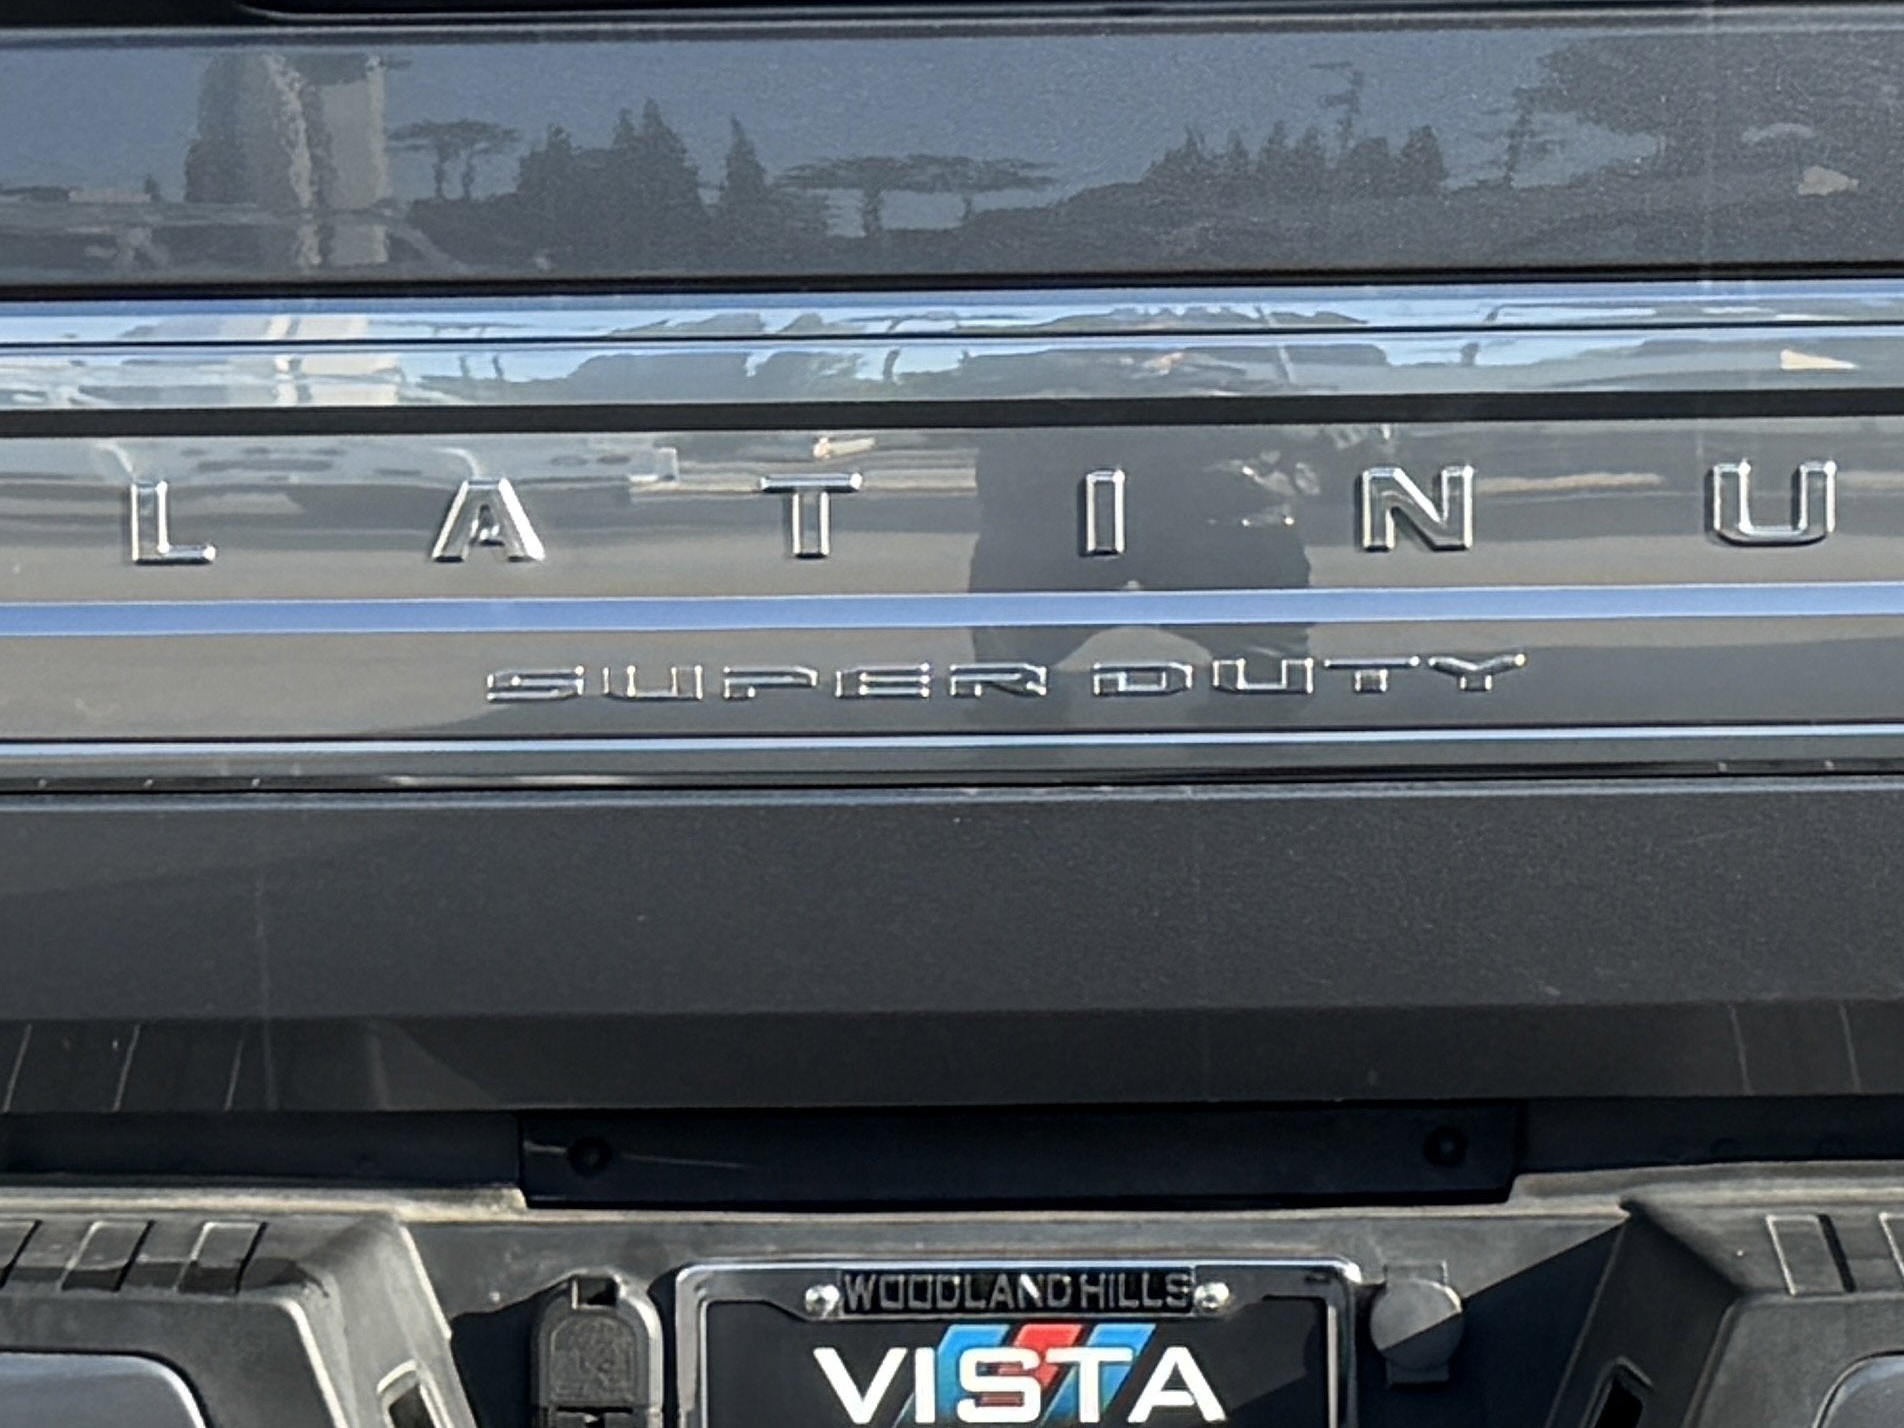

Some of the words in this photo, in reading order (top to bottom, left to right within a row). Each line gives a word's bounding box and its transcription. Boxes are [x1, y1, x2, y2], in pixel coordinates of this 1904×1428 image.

[487, 661, 1047, 701] SUPER
[1092, 653, 1528, 697] DUTY
[843, 1272, 1072, 1311] WOODLAND
[1079, 1271, 1192, 1309] HILLS
[812, 1346, 1227, 1424] VISTA
